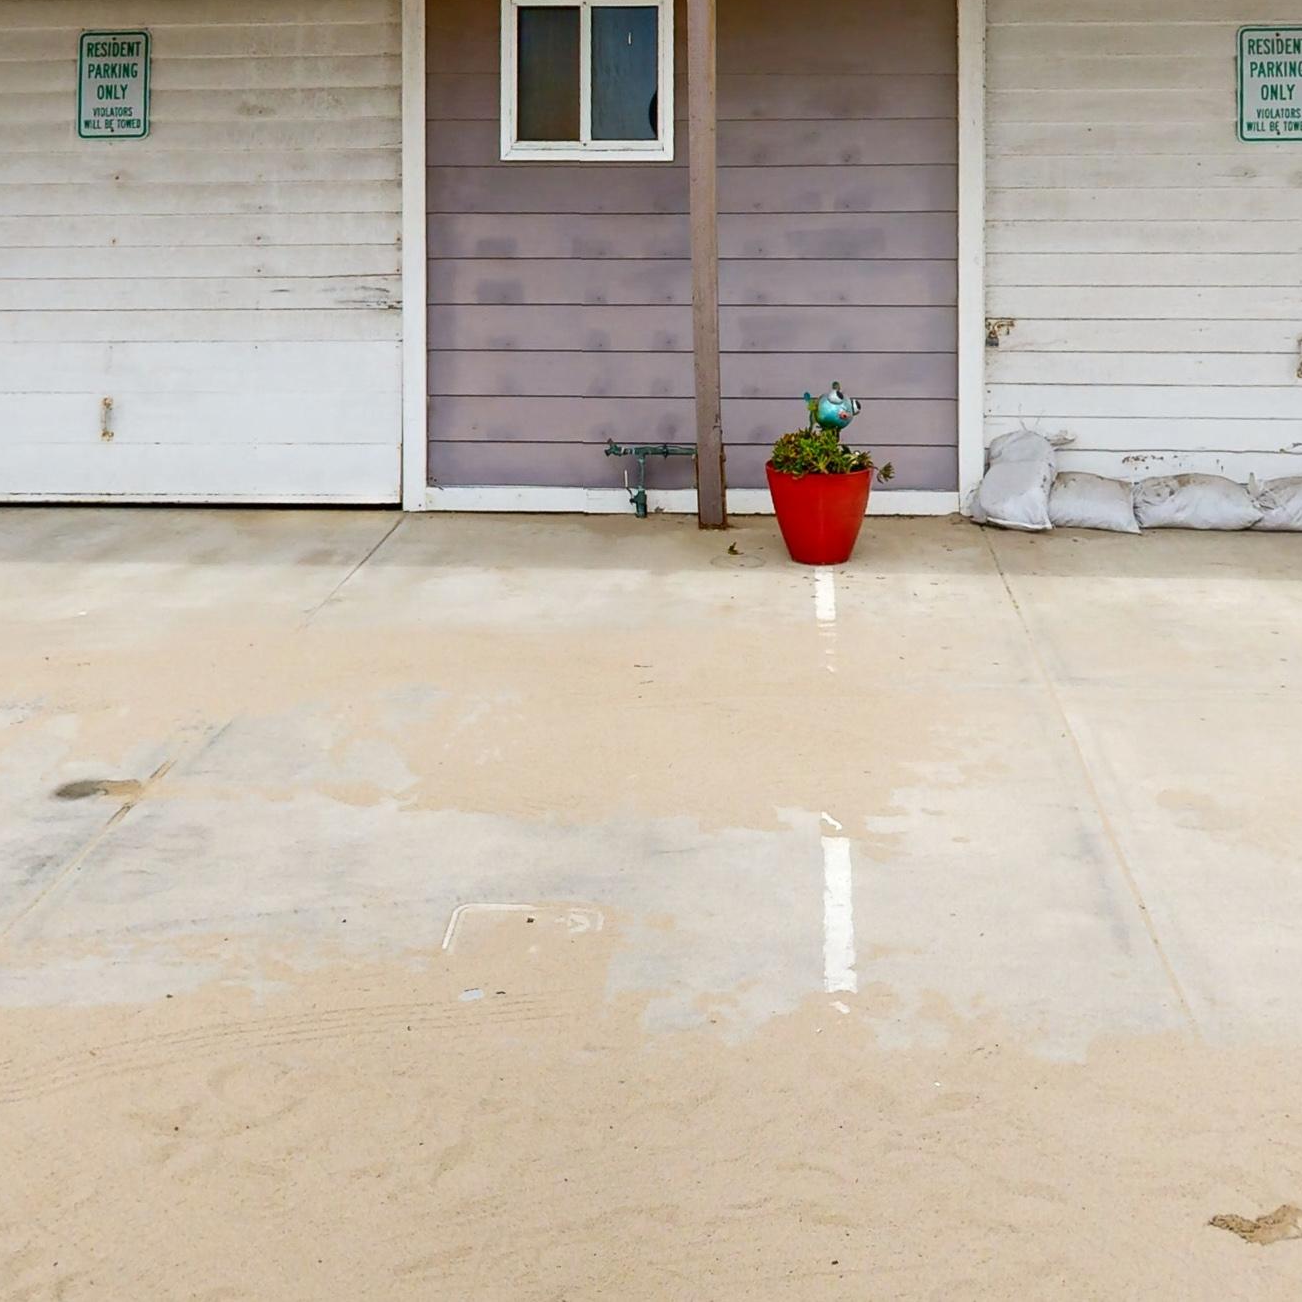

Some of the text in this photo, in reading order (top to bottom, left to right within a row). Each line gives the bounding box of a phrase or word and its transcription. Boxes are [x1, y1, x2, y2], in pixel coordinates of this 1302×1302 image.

[87, 41, 141, 58] RESIDENT
[88, 62, 138, 78] PARKING
[97, 84, 128, 100] ONLY
[1261, 84, 1295, 100] ONLY
[92, 106, 133, 117] VIOLATORS
[1256, 108, 1301, 118] VIOLATORS
[84, 119, 141, 129] WILL BE TOWED
[1246, 122, 1265, 131] WILL
[1269, 121, 1279, 131] BE
